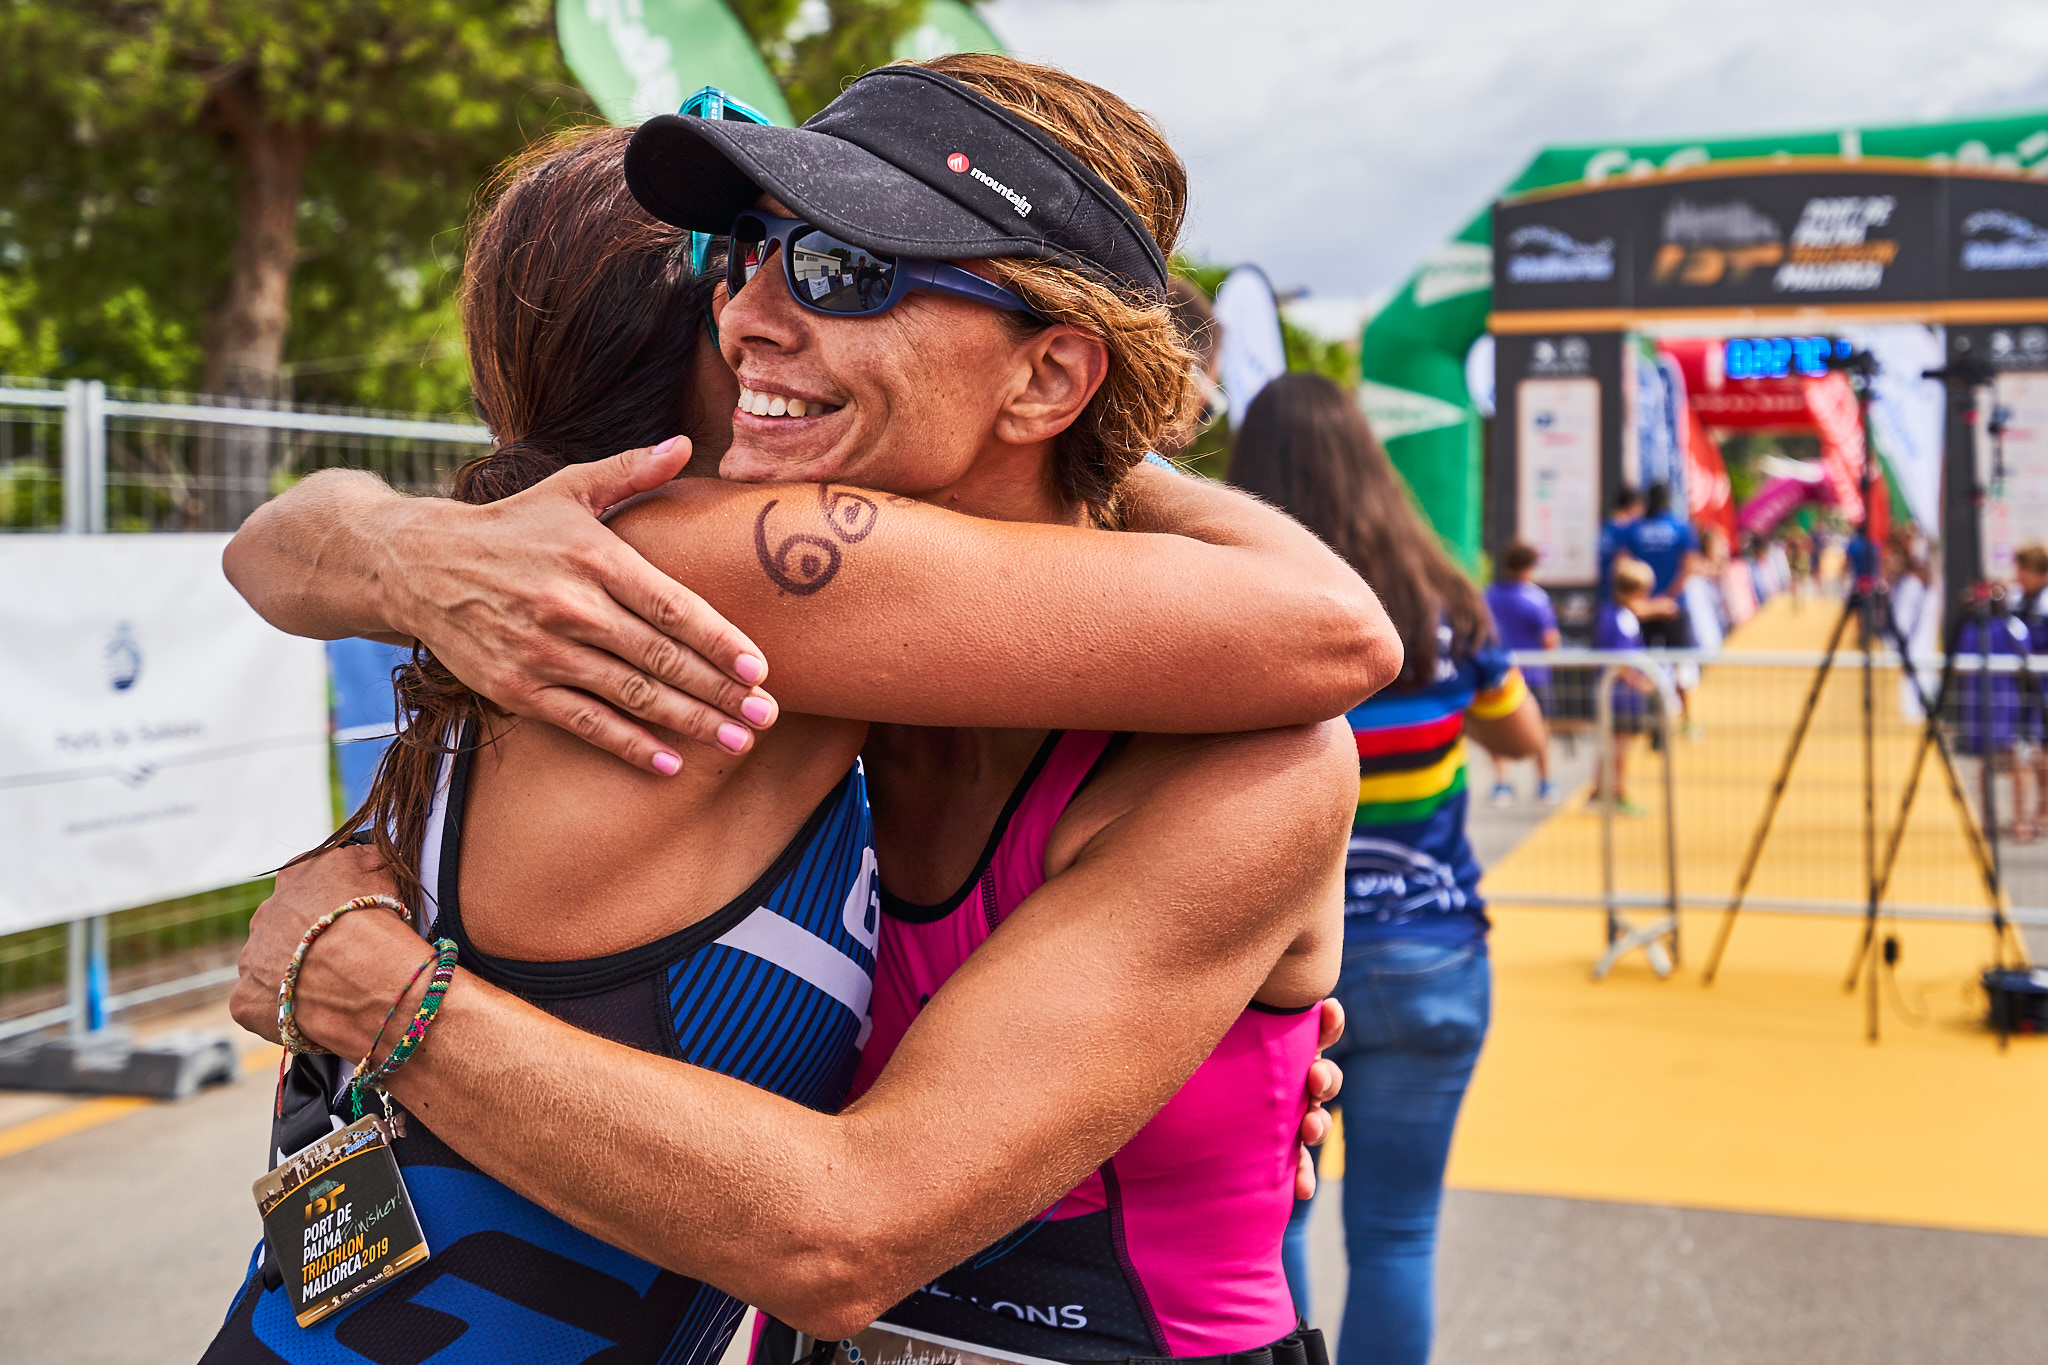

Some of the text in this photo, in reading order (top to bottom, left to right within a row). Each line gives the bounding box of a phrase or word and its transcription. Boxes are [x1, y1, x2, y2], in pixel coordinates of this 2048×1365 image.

[970, 167, 1032, 214] mountain
[303, 1202, 353, 1247] PORT DE
[303, 1228, 342, 1265] PALMA
[302, 1232, 364, 1284] TRIATHLON
[302, 1237, 389, 1303] MALLORCA 2019
